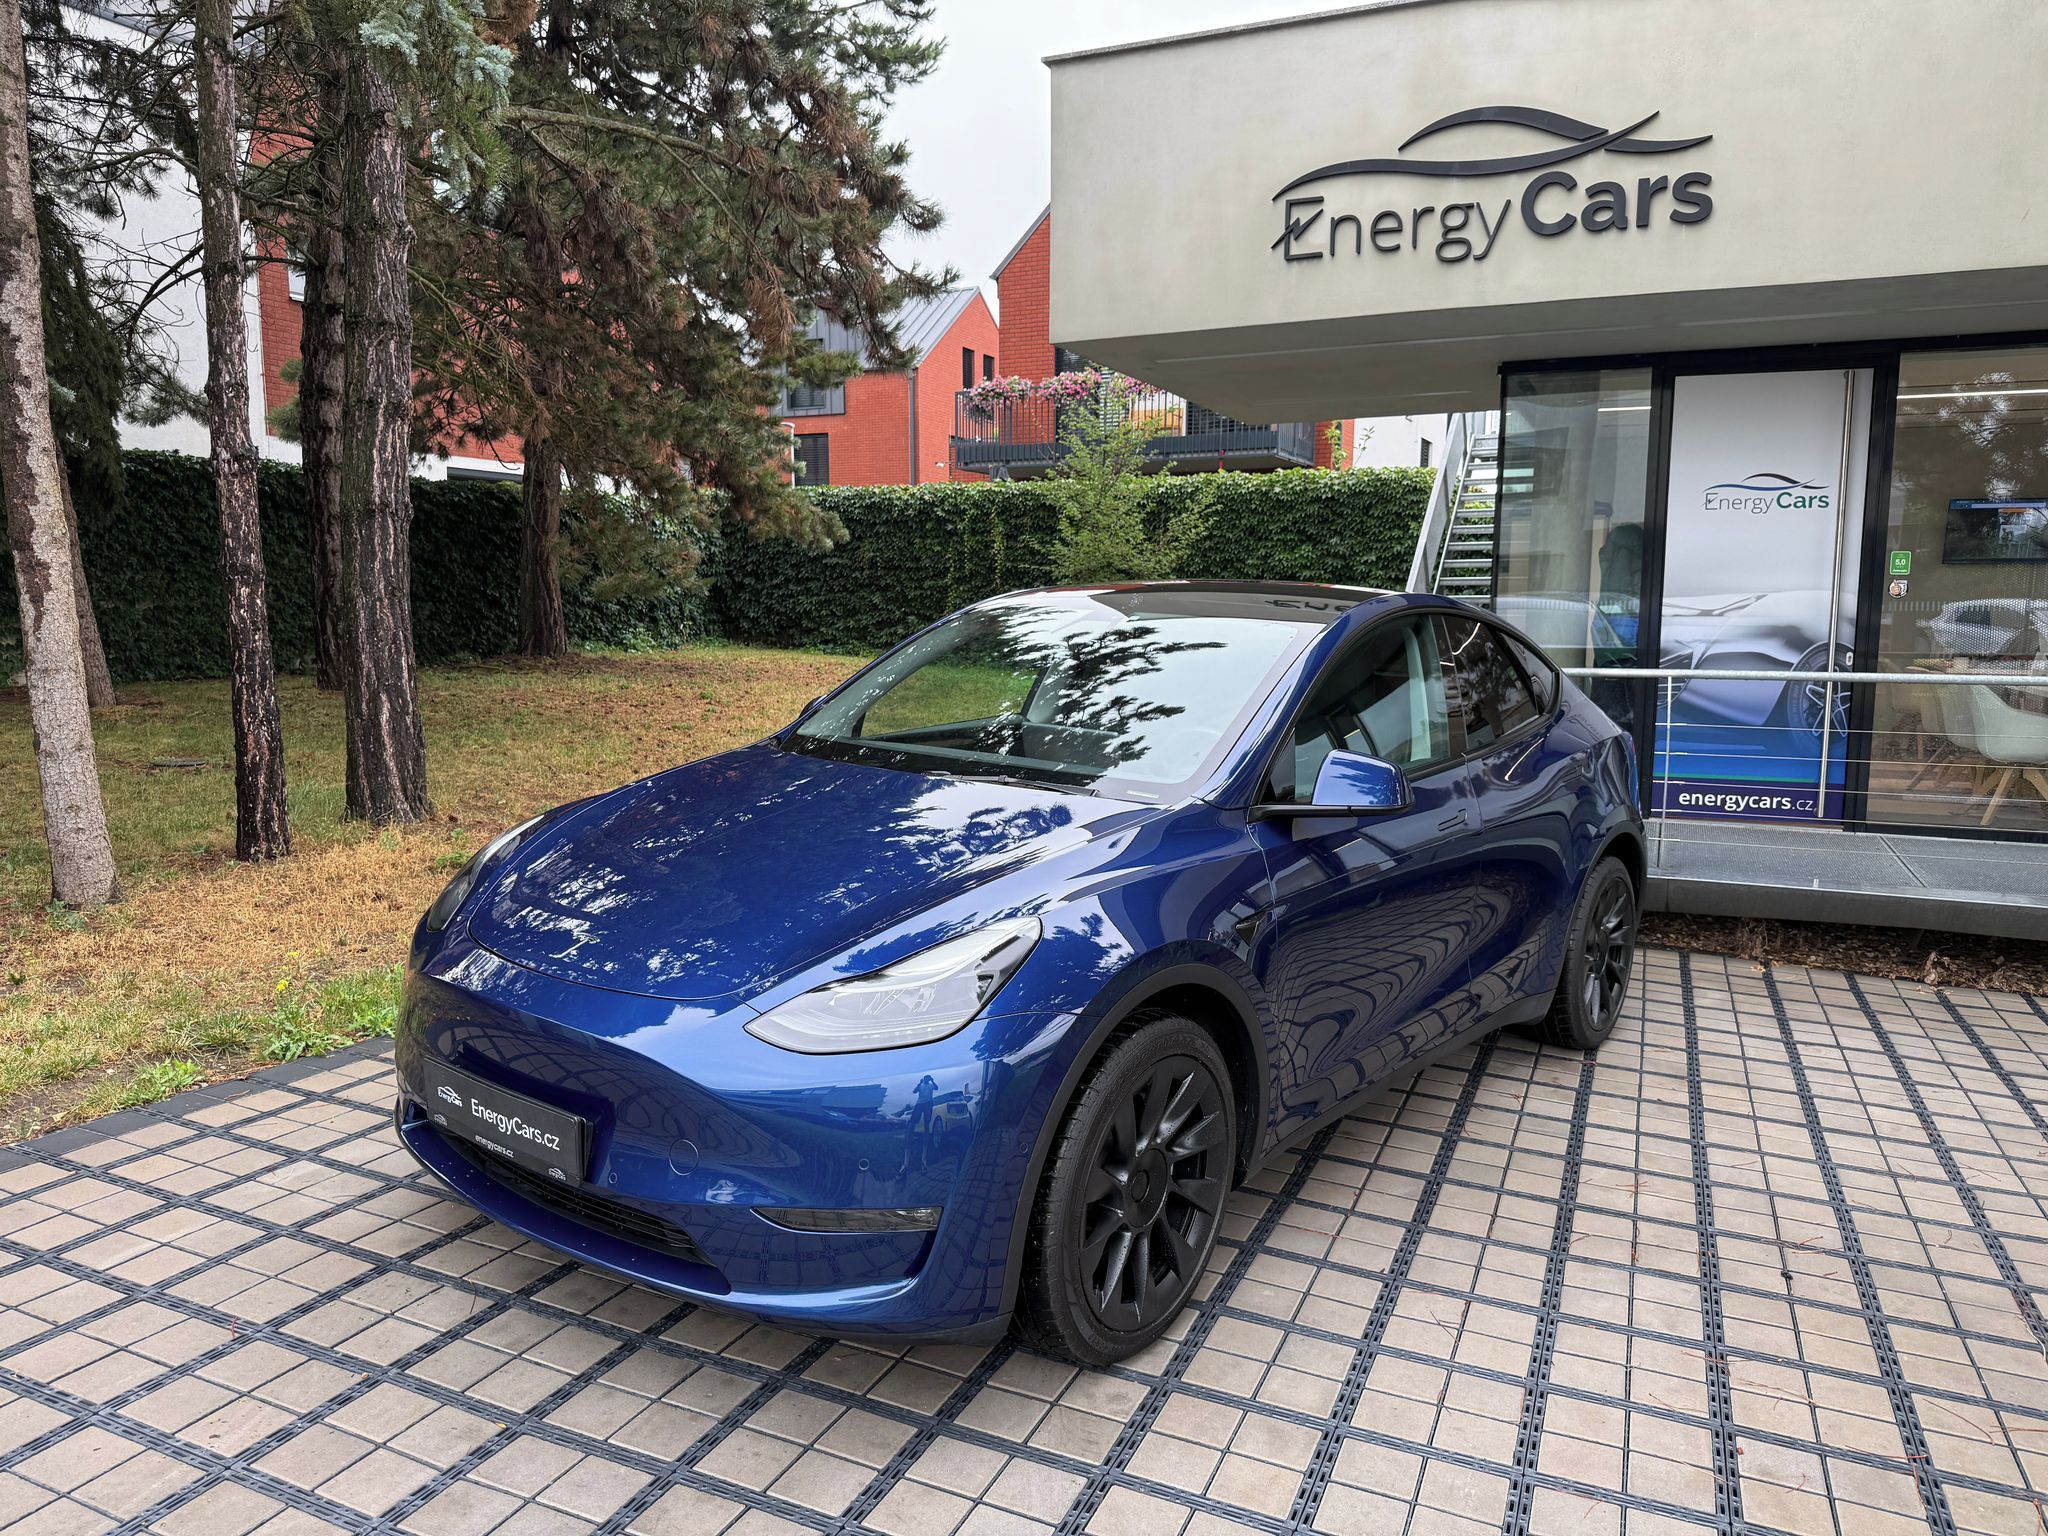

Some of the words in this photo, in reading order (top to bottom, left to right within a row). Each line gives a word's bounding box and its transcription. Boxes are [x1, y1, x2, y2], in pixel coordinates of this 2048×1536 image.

[1272, 171, 1714, 263] EnergyCars
[1678, 792, 1814, 812] energycars.cz
[471, 1097, 560, 1151] EnergyCars.cz
